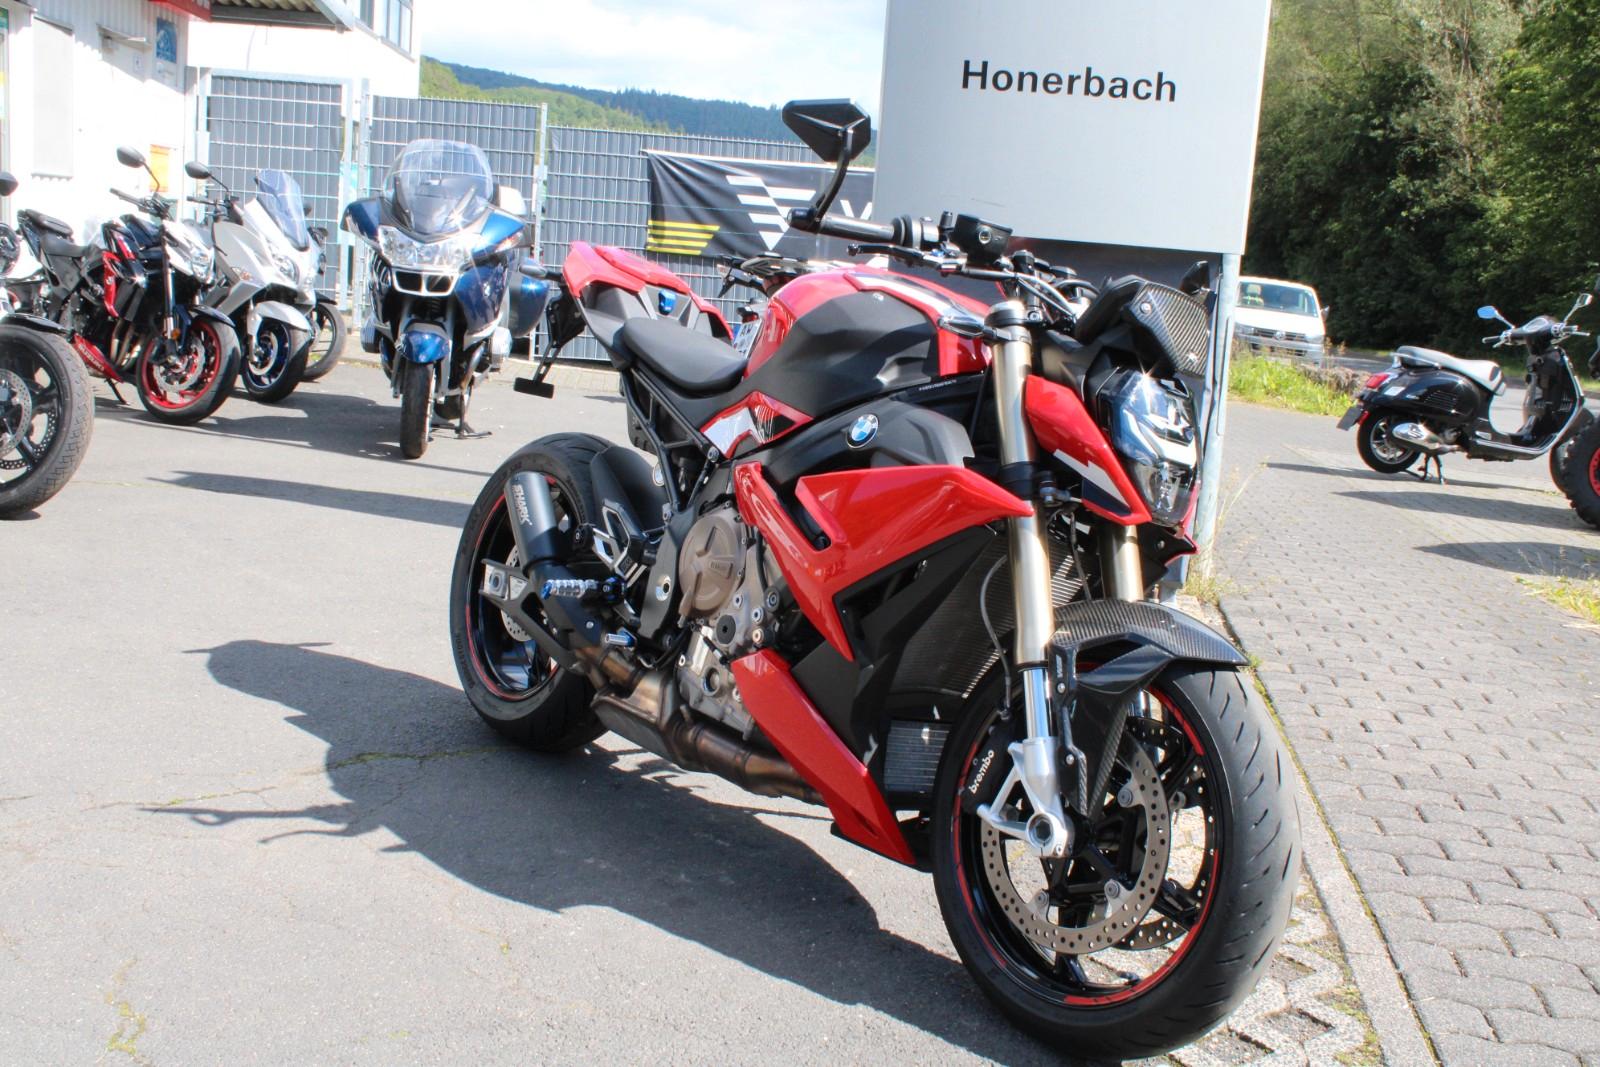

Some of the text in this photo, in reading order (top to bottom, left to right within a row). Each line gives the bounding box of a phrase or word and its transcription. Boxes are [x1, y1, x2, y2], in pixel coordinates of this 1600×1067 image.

[961, 59, 1177, 103] Honerbach
[511, 484, 533, 526] SHARK
[968, 750, 994, 794] brembo
